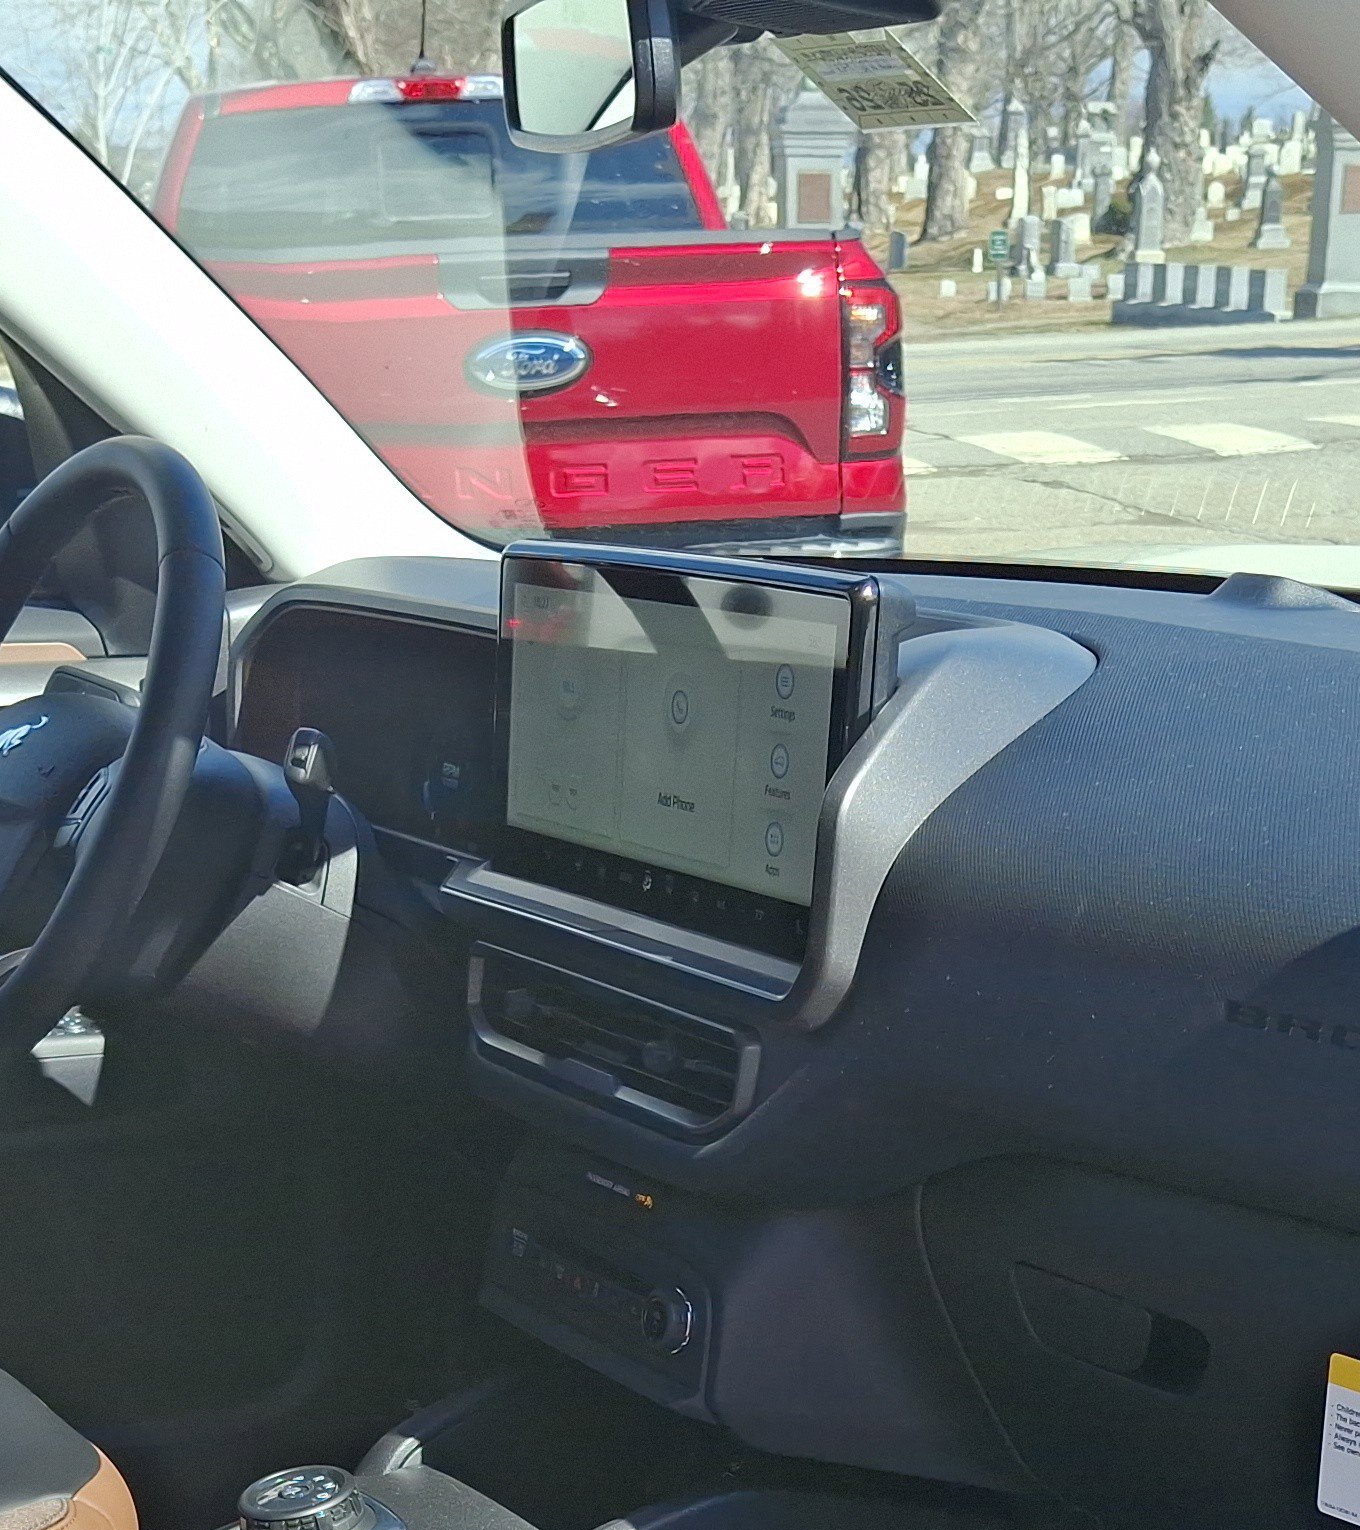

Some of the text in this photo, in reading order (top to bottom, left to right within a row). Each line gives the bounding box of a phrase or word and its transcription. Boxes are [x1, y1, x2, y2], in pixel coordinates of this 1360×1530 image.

[770, 706, 796, 722] Settings
[657, 792, 695, 812] Add Phone
[1336, 1412, 1348, 1423] The
[1335, 1422, 1354, 1435] Never
[1334, 1432, 1357, 1446] Always
